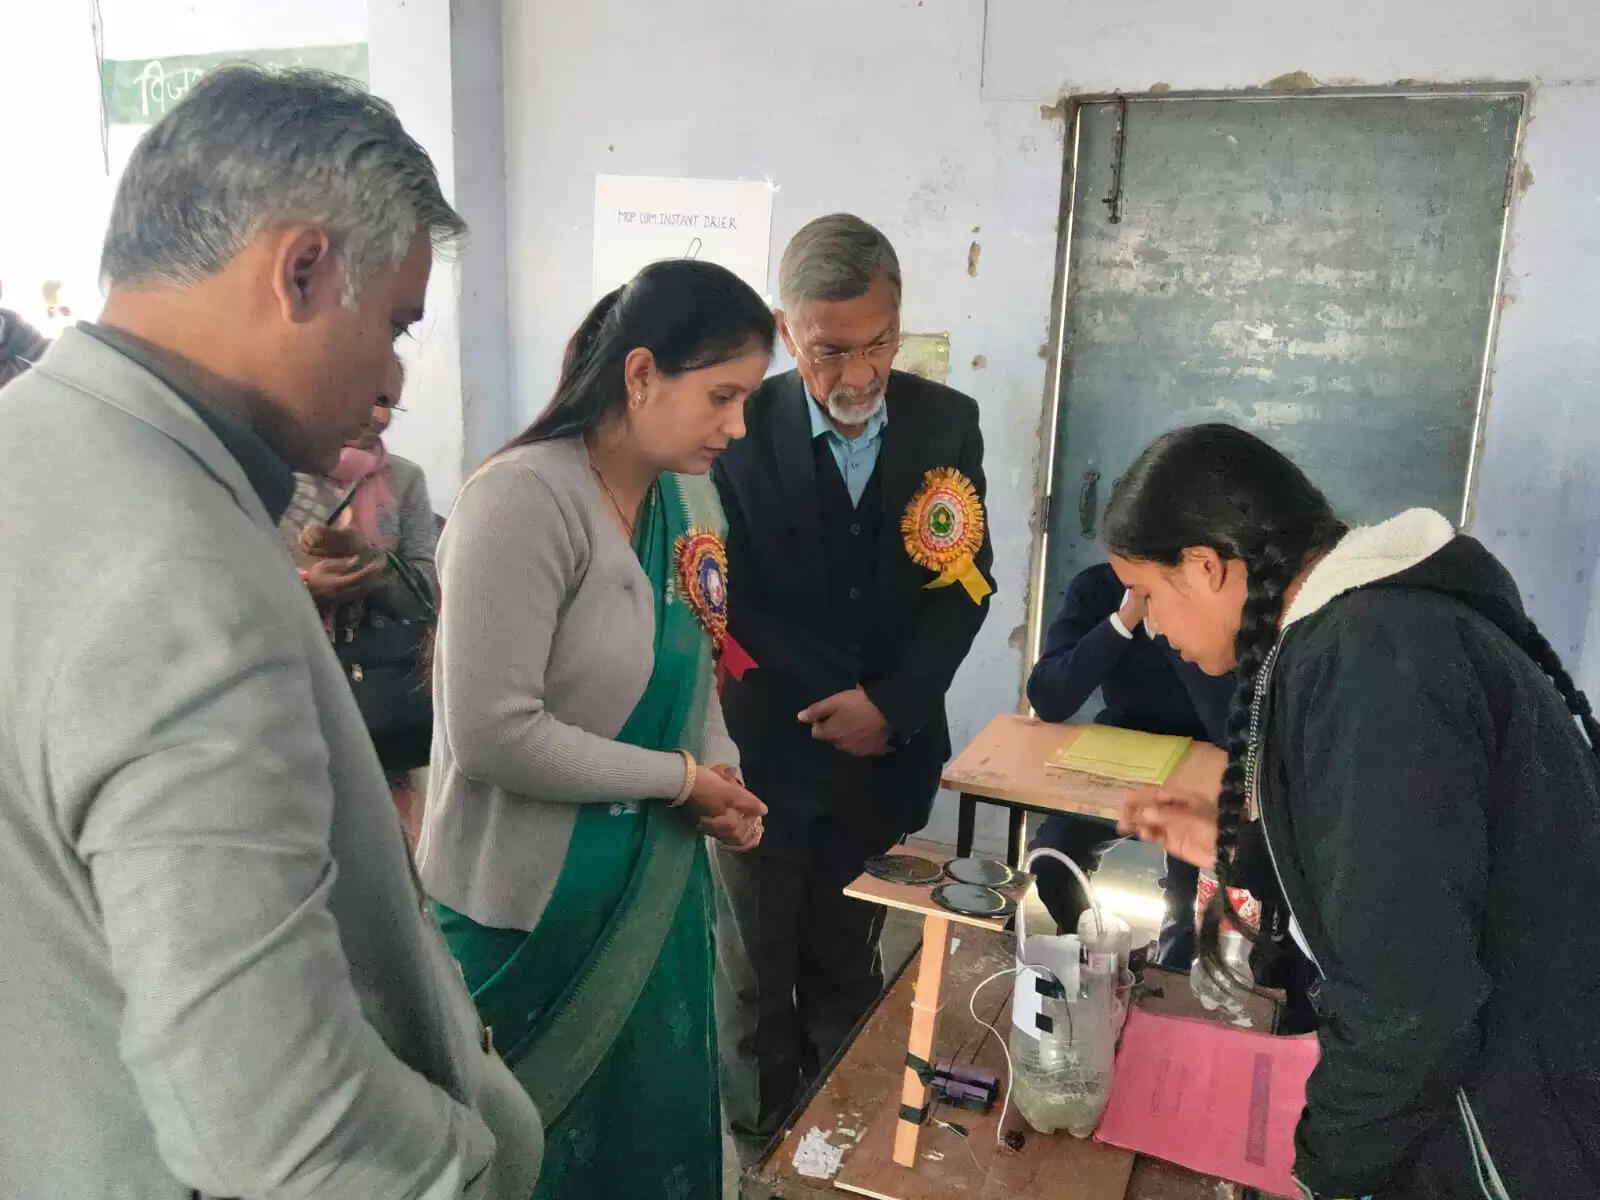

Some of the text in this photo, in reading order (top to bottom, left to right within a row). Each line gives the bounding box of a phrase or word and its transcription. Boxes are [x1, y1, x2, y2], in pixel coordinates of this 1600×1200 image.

[617, 210, 737, 230] MOP CUM INSTANT DRIER
